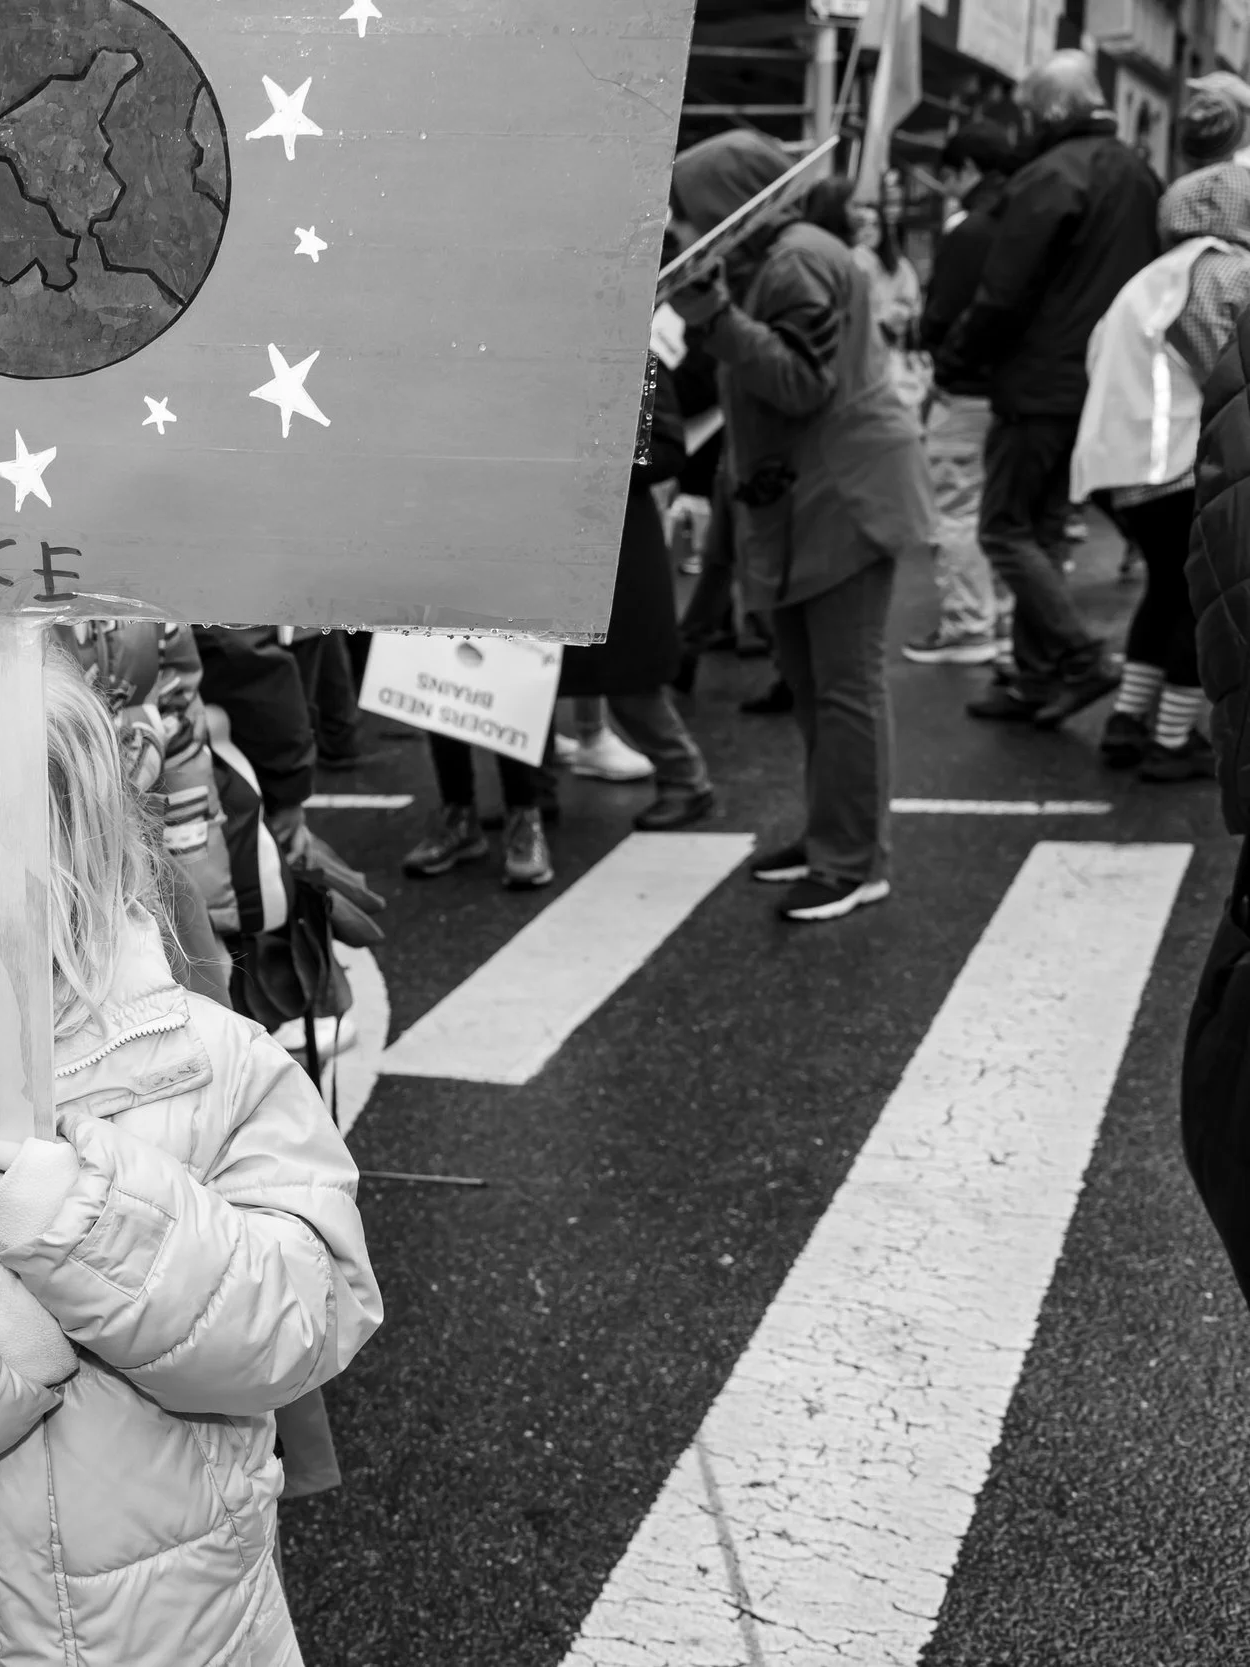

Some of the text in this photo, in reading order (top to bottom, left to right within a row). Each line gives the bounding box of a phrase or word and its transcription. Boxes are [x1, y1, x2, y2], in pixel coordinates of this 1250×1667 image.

[417, 672, 495, 709] BRAINS
[378, 687, 528, 749] LEADERS NEED
